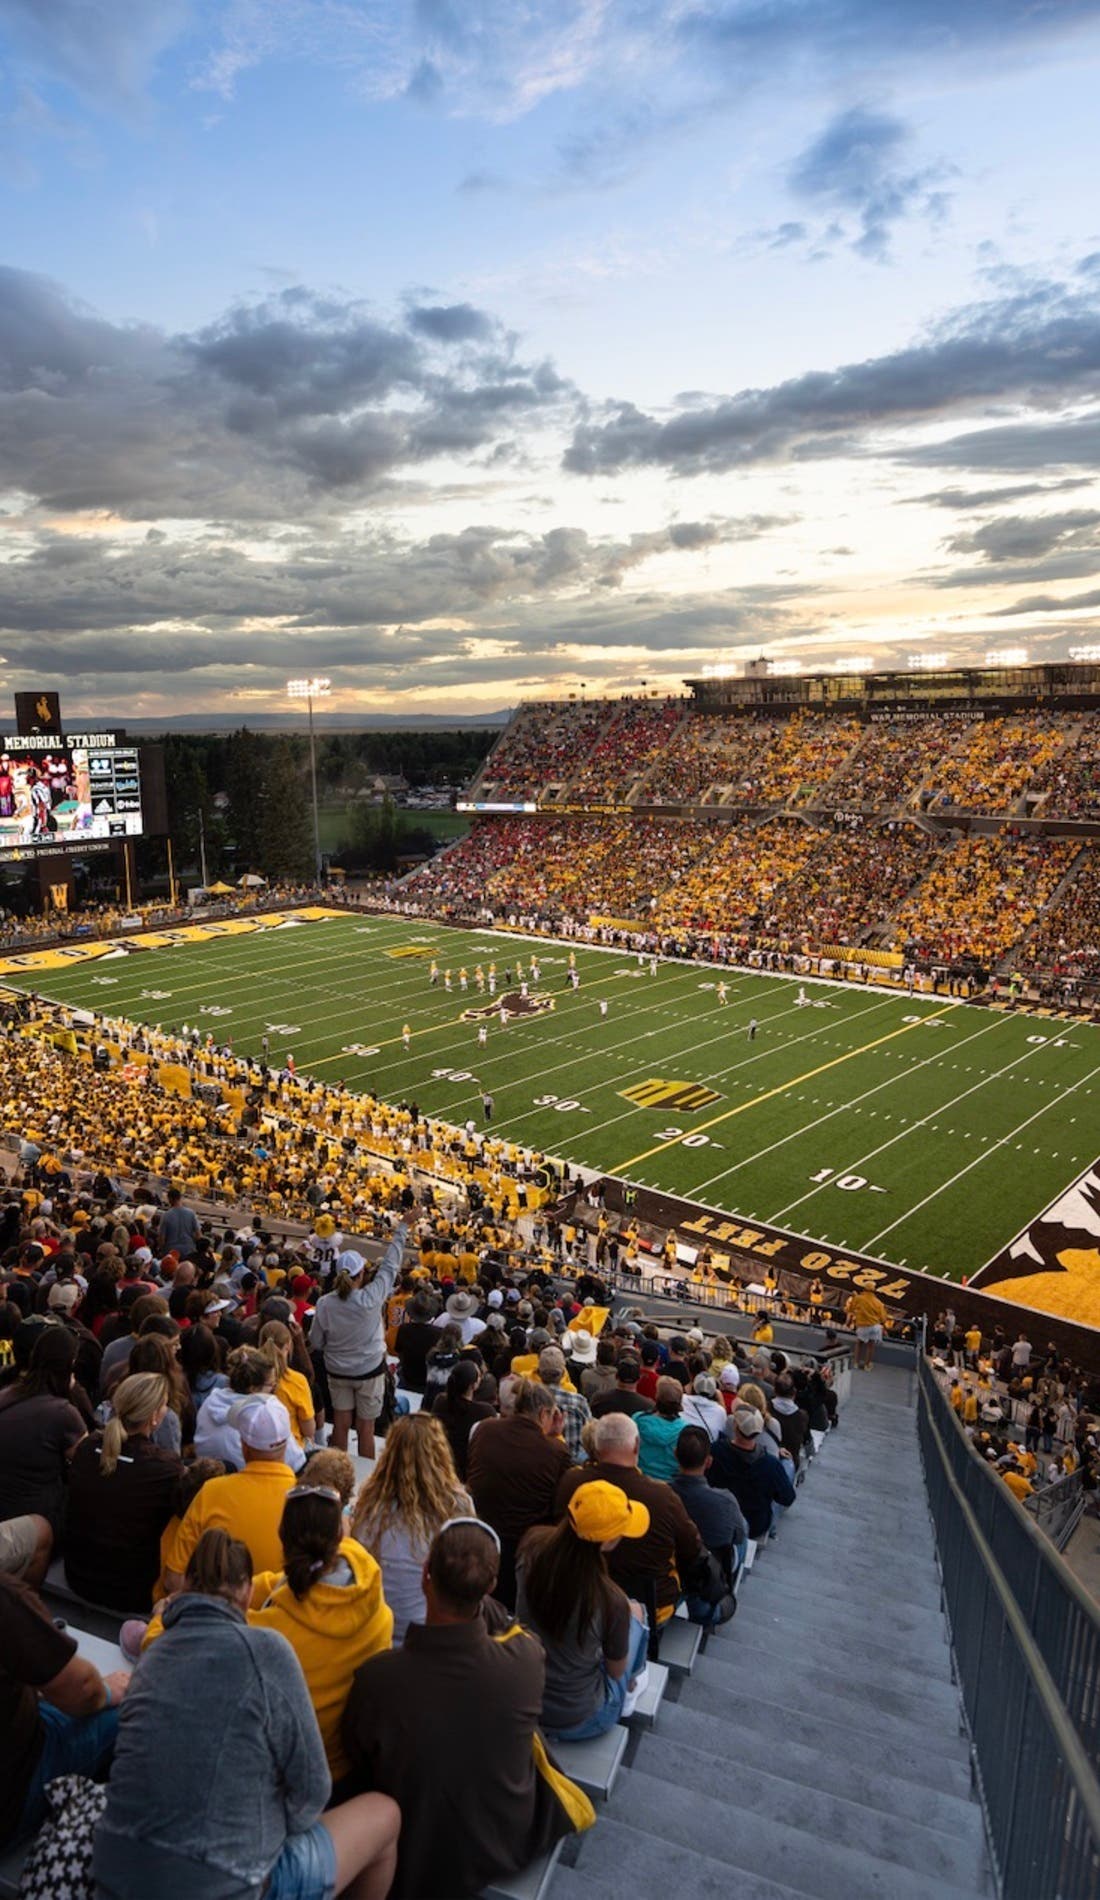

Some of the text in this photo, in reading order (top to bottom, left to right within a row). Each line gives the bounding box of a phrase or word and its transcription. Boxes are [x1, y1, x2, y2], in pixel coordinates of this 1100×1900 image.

[871, 713, 891, 721] WAR
[943, 712, 985, 720] STADIUM
[4, 734, 116, 750] MEMORIAL STADIUM
[430, 1068, 472, 1082] 40
[531, 1094, 580, 1112] 30
[652, 1127, 710, 1148] 20
[808, 1167, 868, 1191] 10
[679, 1214, 911, 1300] 7220 FEET
